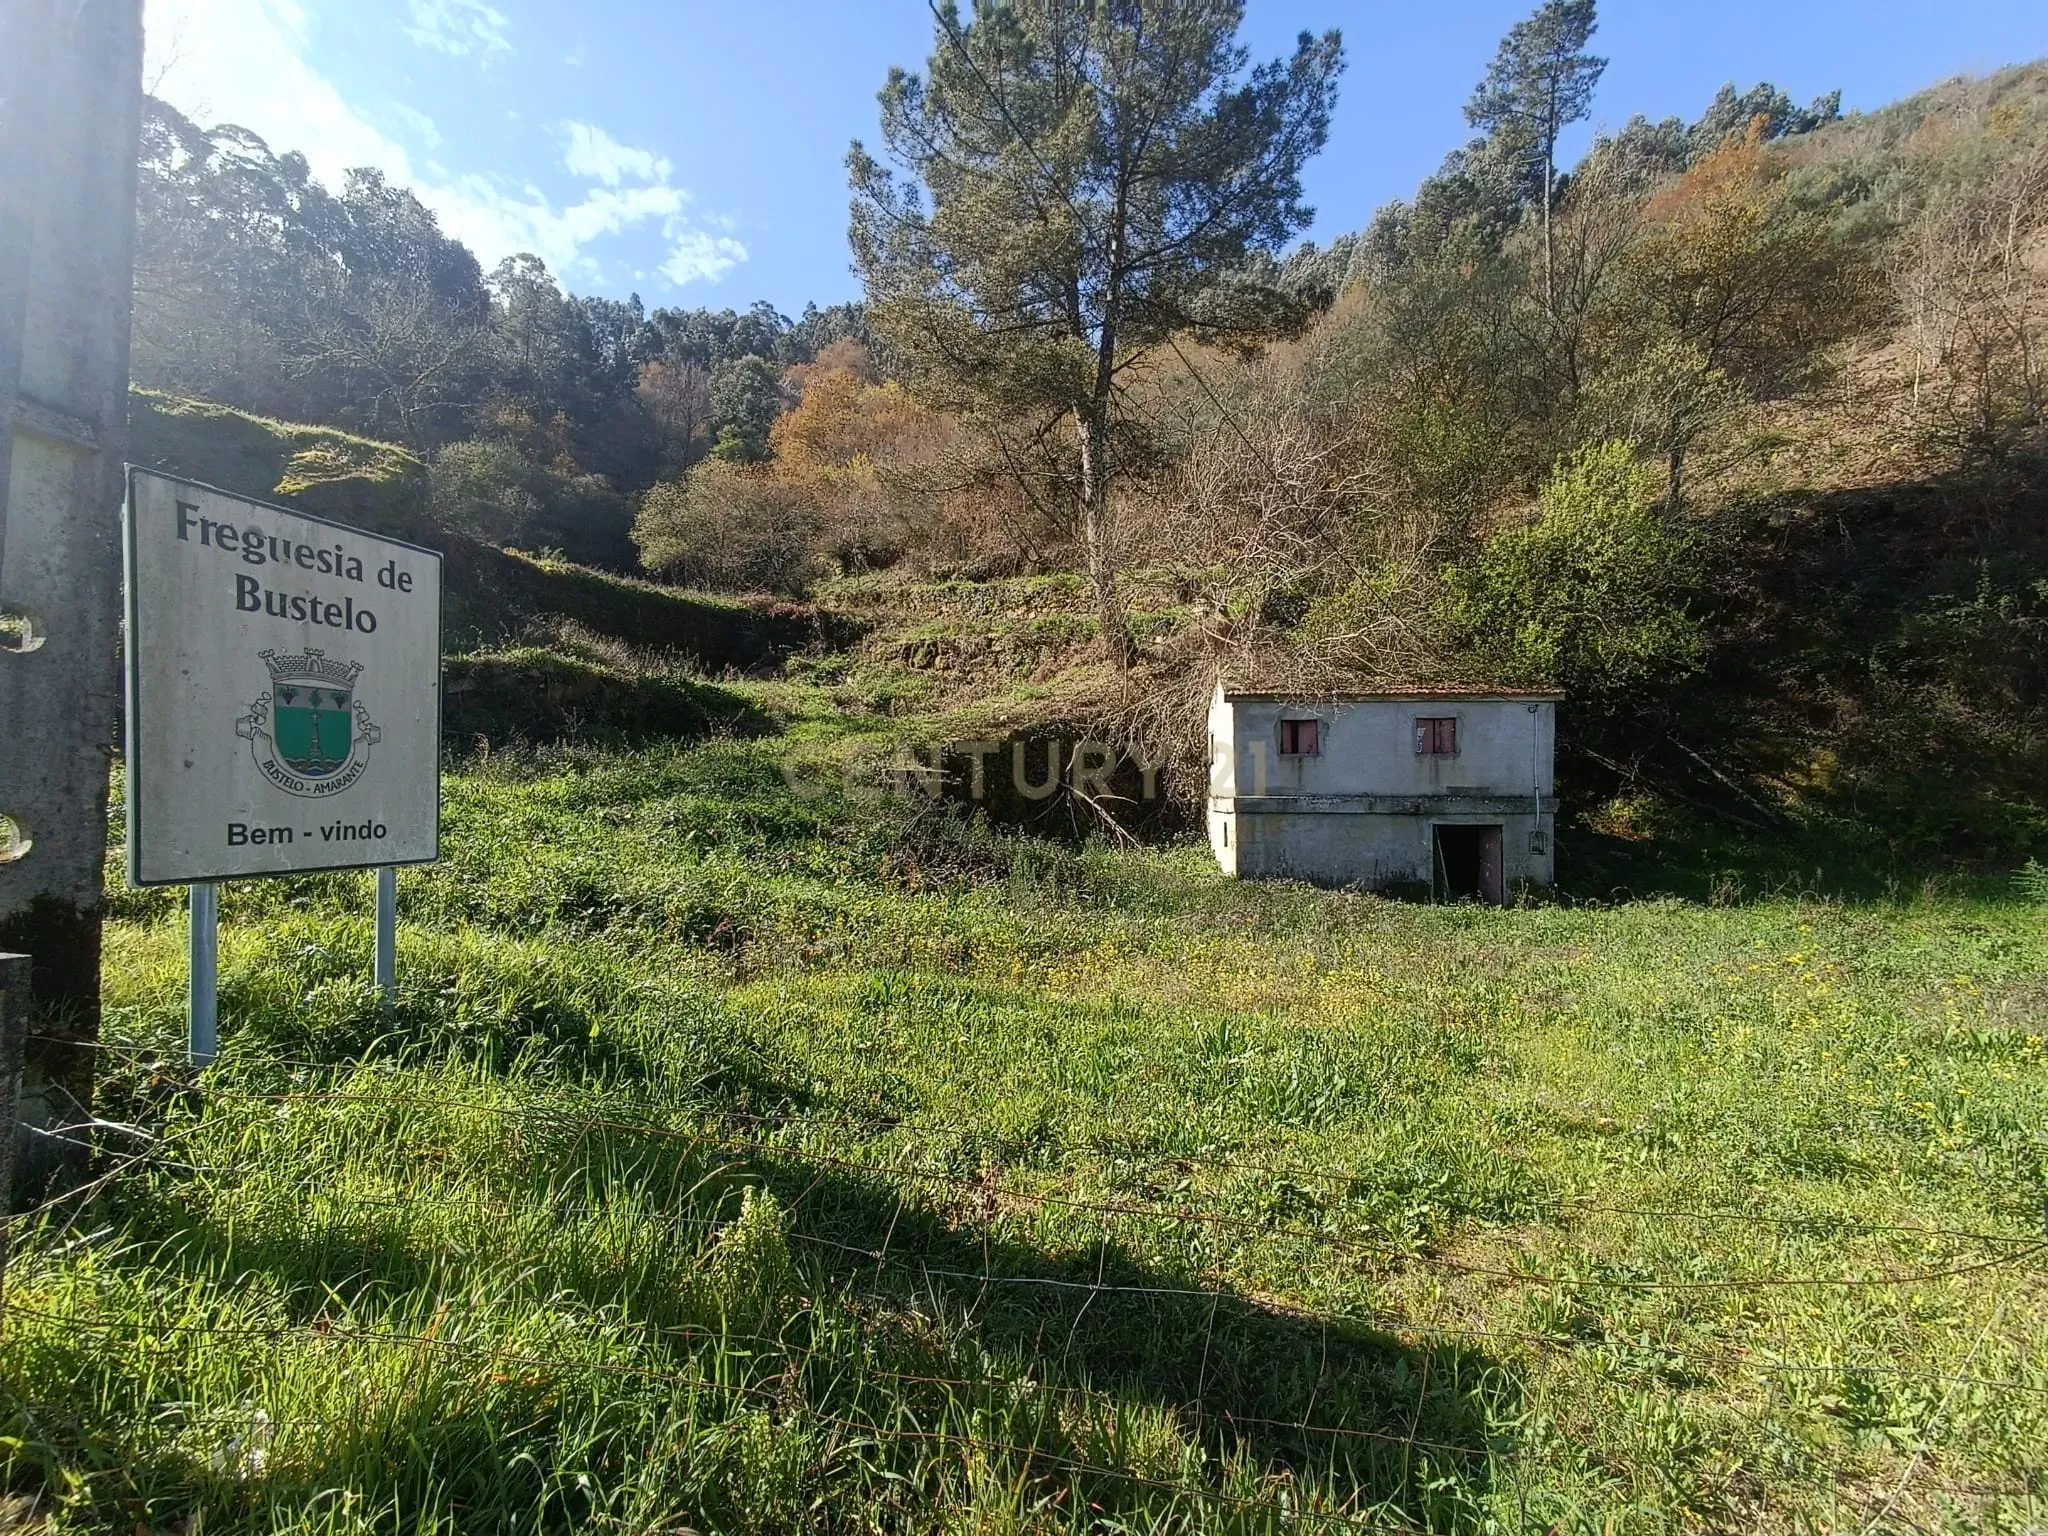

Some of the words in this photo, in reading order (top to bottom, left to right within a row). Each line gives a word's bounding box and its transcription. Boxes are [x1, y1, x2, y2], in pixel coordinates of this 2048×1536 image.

[175, 500, 363, 582] Freguesia
[377, 560, 413, 593] de
[235, 573, 377, 634] Bustelo
[263, 760, 304, 791] BUSTELO
[313, 761, 363, 794] AMARANTE
[227, 823, 293, 845] Bem
[320, 820, 387, 841] vindo
